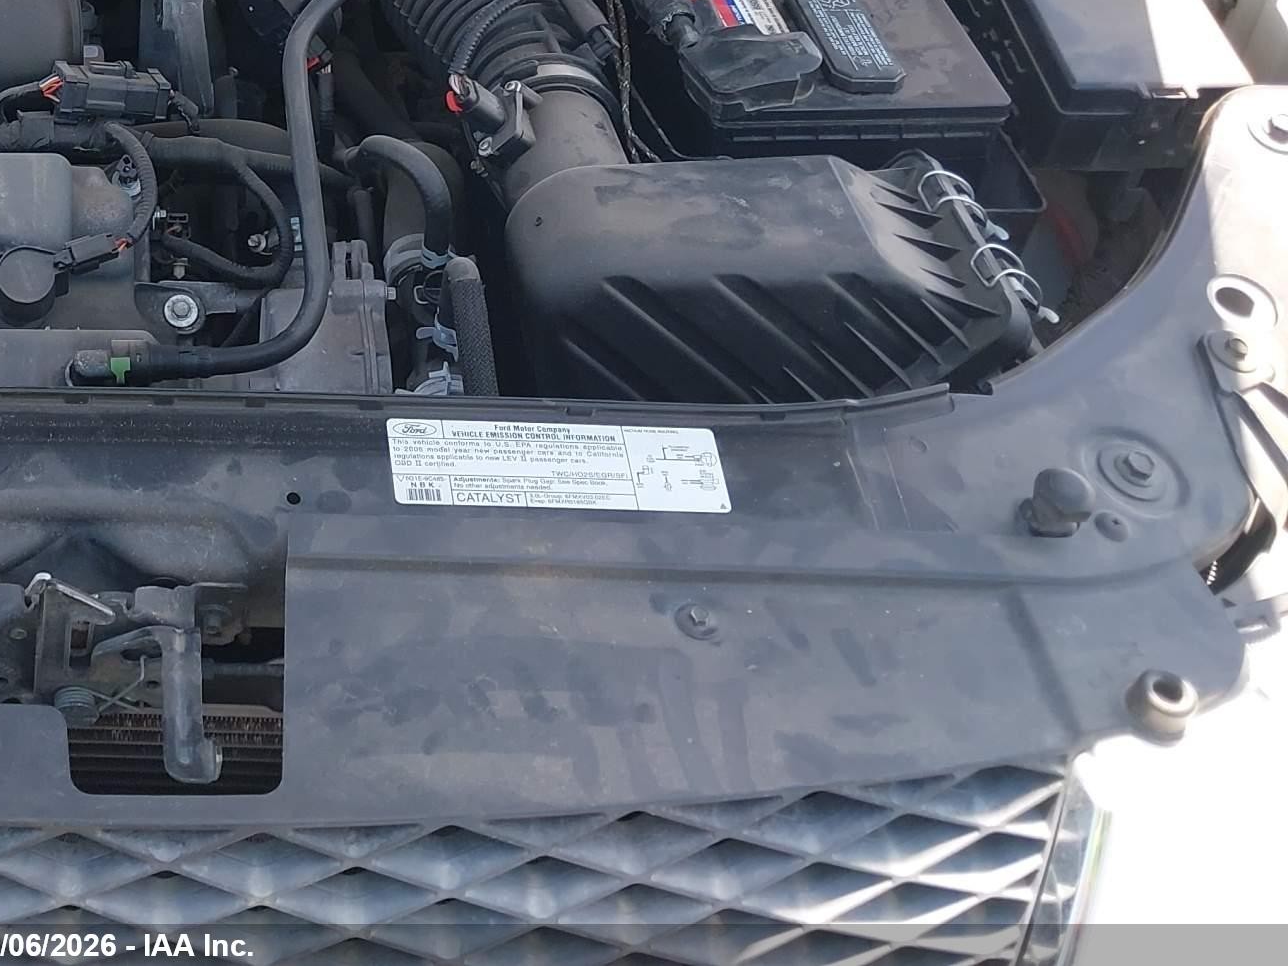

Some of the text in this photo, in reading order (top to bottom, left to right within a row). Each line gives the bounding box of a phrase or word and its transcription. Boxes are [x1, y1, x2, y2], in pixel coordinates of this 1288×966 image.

[402, 424, 427, 434] Ford
[537, 426, 570, 434] Company
[456, 492, 521, 503] CATALYST
